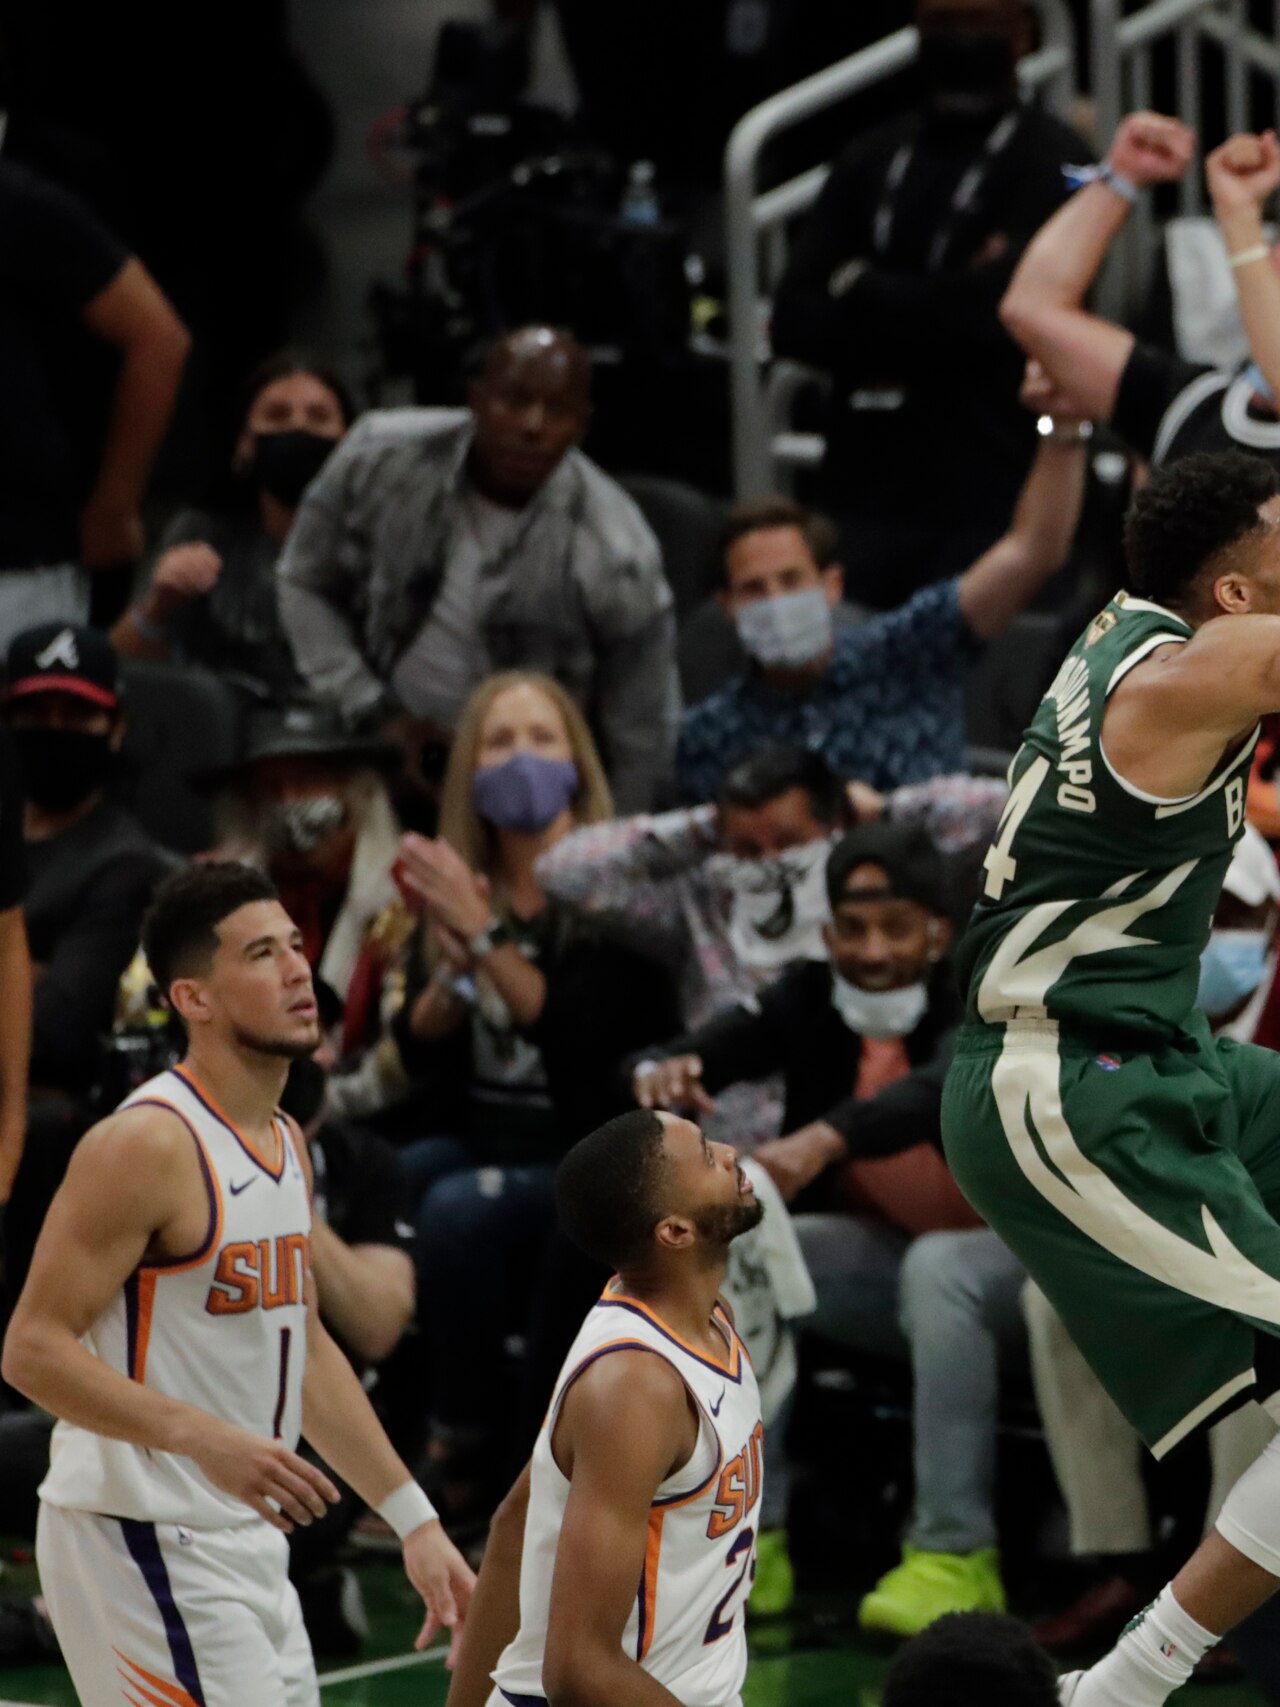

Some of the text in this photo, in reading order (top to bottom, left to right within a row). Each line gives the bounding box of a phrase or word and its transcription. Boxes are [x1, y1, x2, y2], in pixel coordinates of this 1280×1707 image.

[1224, 776, 1246, 840] B
[273, 1327, 291, 1439] 1
[702, 1526, 756, 1647] 2
